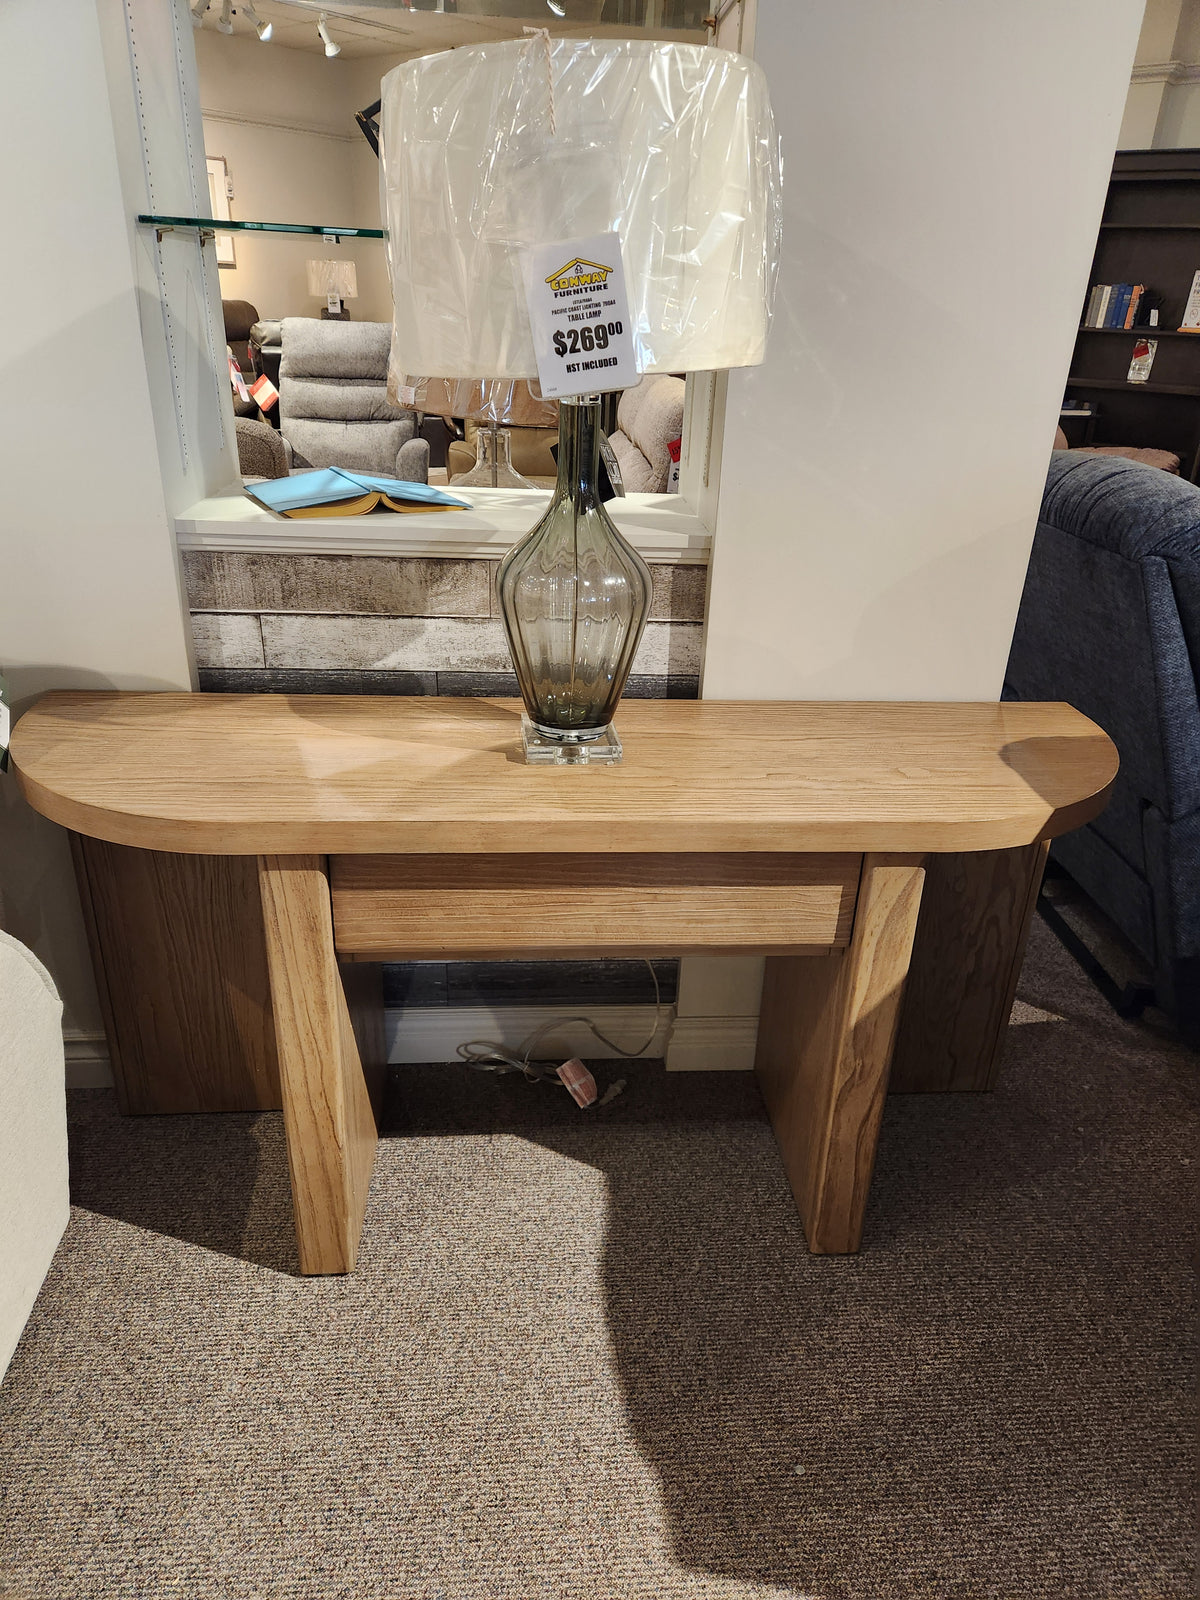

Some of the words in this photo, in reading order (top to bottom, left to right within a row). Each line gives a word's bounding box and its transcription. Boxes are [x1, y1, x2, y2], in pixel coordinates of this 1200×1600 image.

[550, 271, 608, 291] CONWAY
[554, 283, 609, 298] FURNITURE
[551, 307, 567, 315] PACIFIC
[567, 304, 582, 313] COAST
[581, 302, 601, 310] LIGHTING
[567, 312, 585, 322] TABLE
[585, 310, 602, 319] LAMP
[566, 361, 581, 374] HST
[581, 357, 618, 371] INCLUDED
